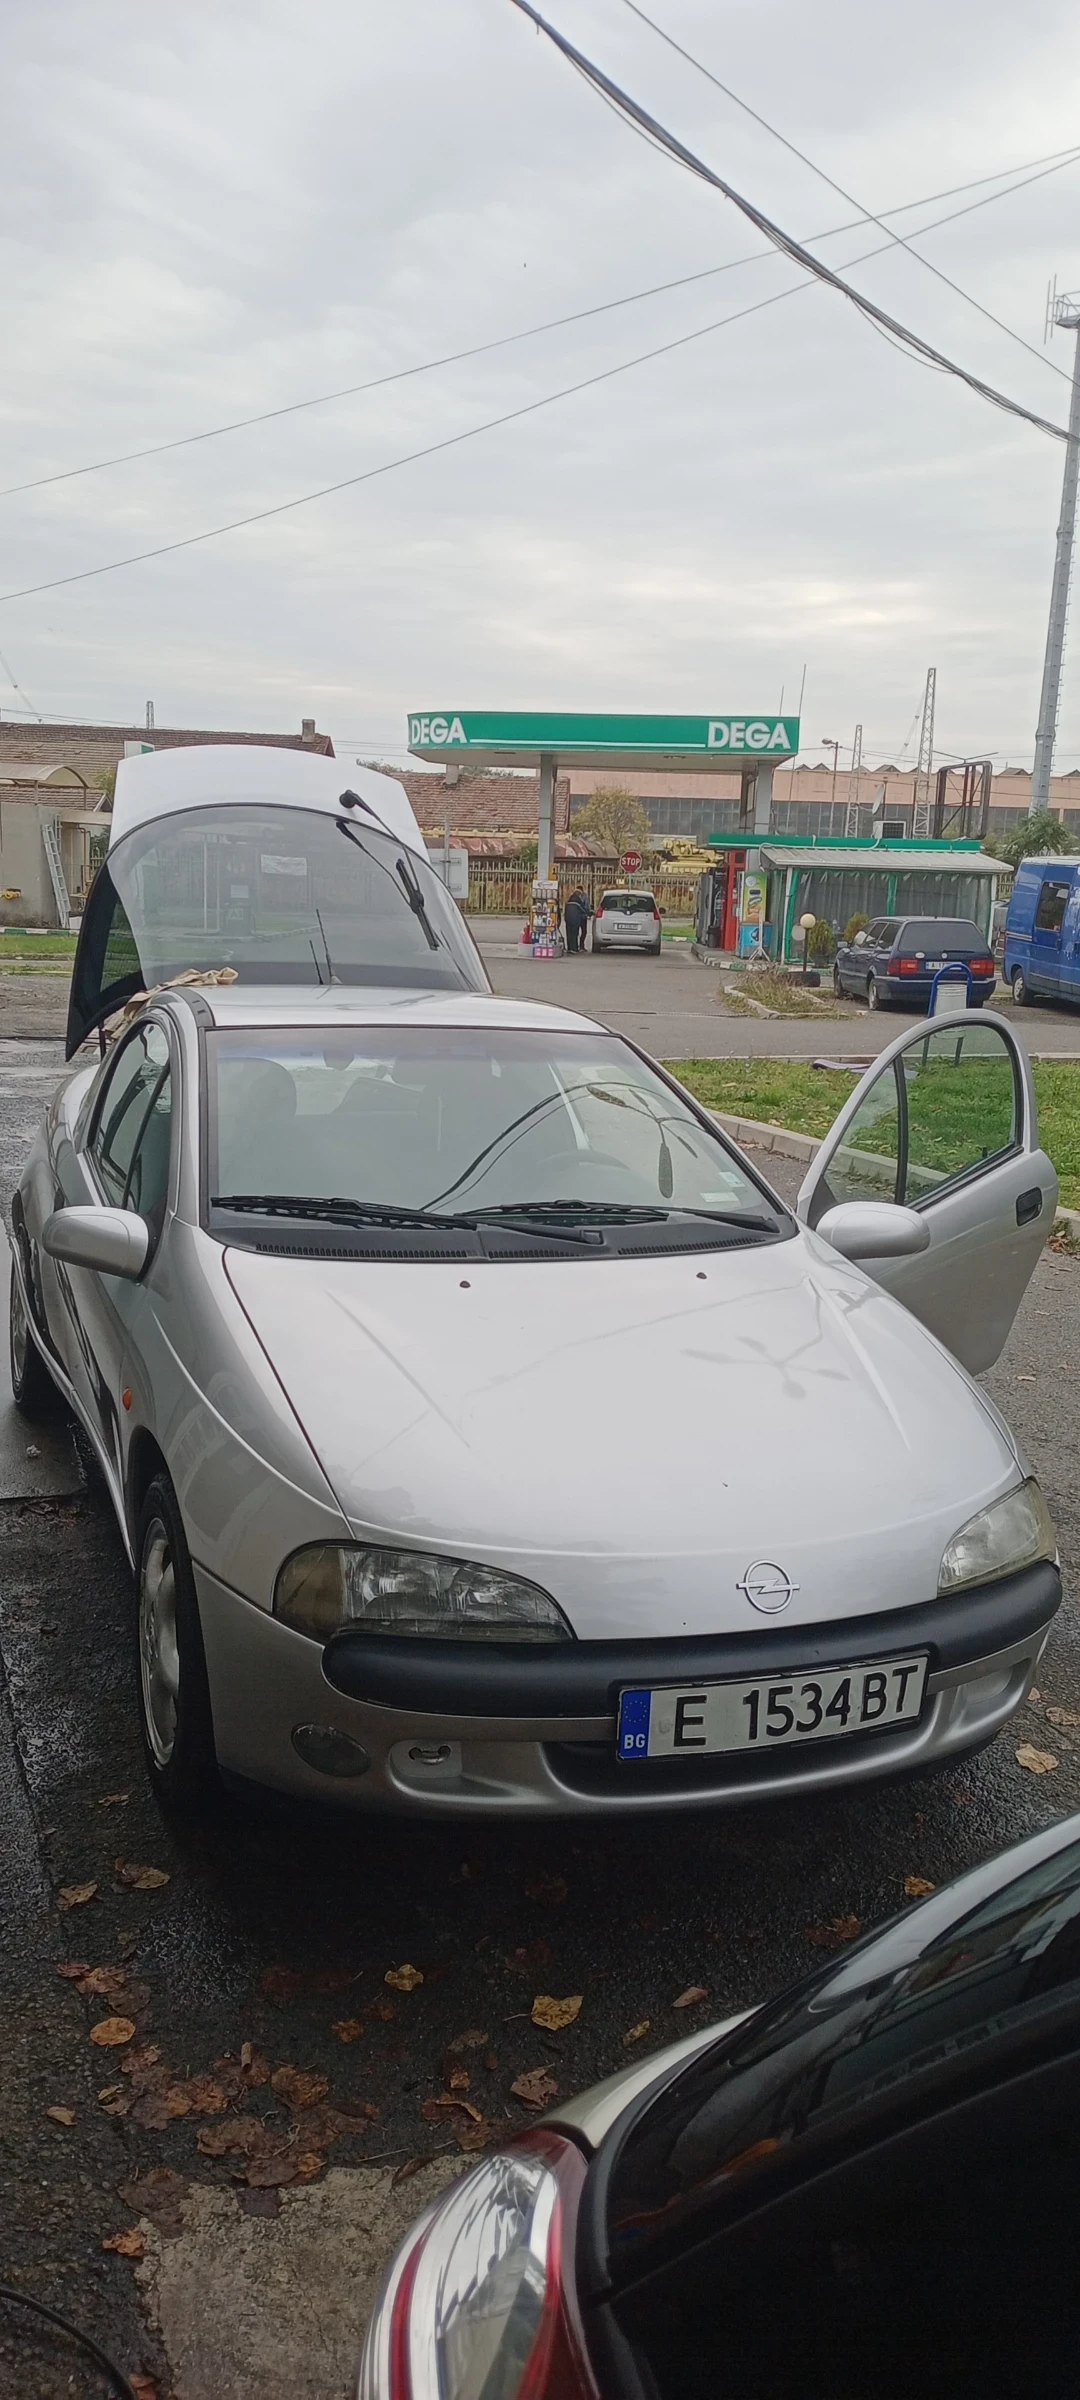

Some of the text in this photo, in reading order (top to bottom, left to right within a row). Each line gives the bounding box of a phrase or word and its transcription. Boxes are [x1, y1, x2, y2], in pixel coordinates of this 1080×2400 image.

[410, 717, 468, 745] DEGA
[707, 721, 792, 749] DEGA
[621, 856, 641, 866] STOP
[673, 1694, 708, 1748] E
[623, 1733, 646, 1750] BG
